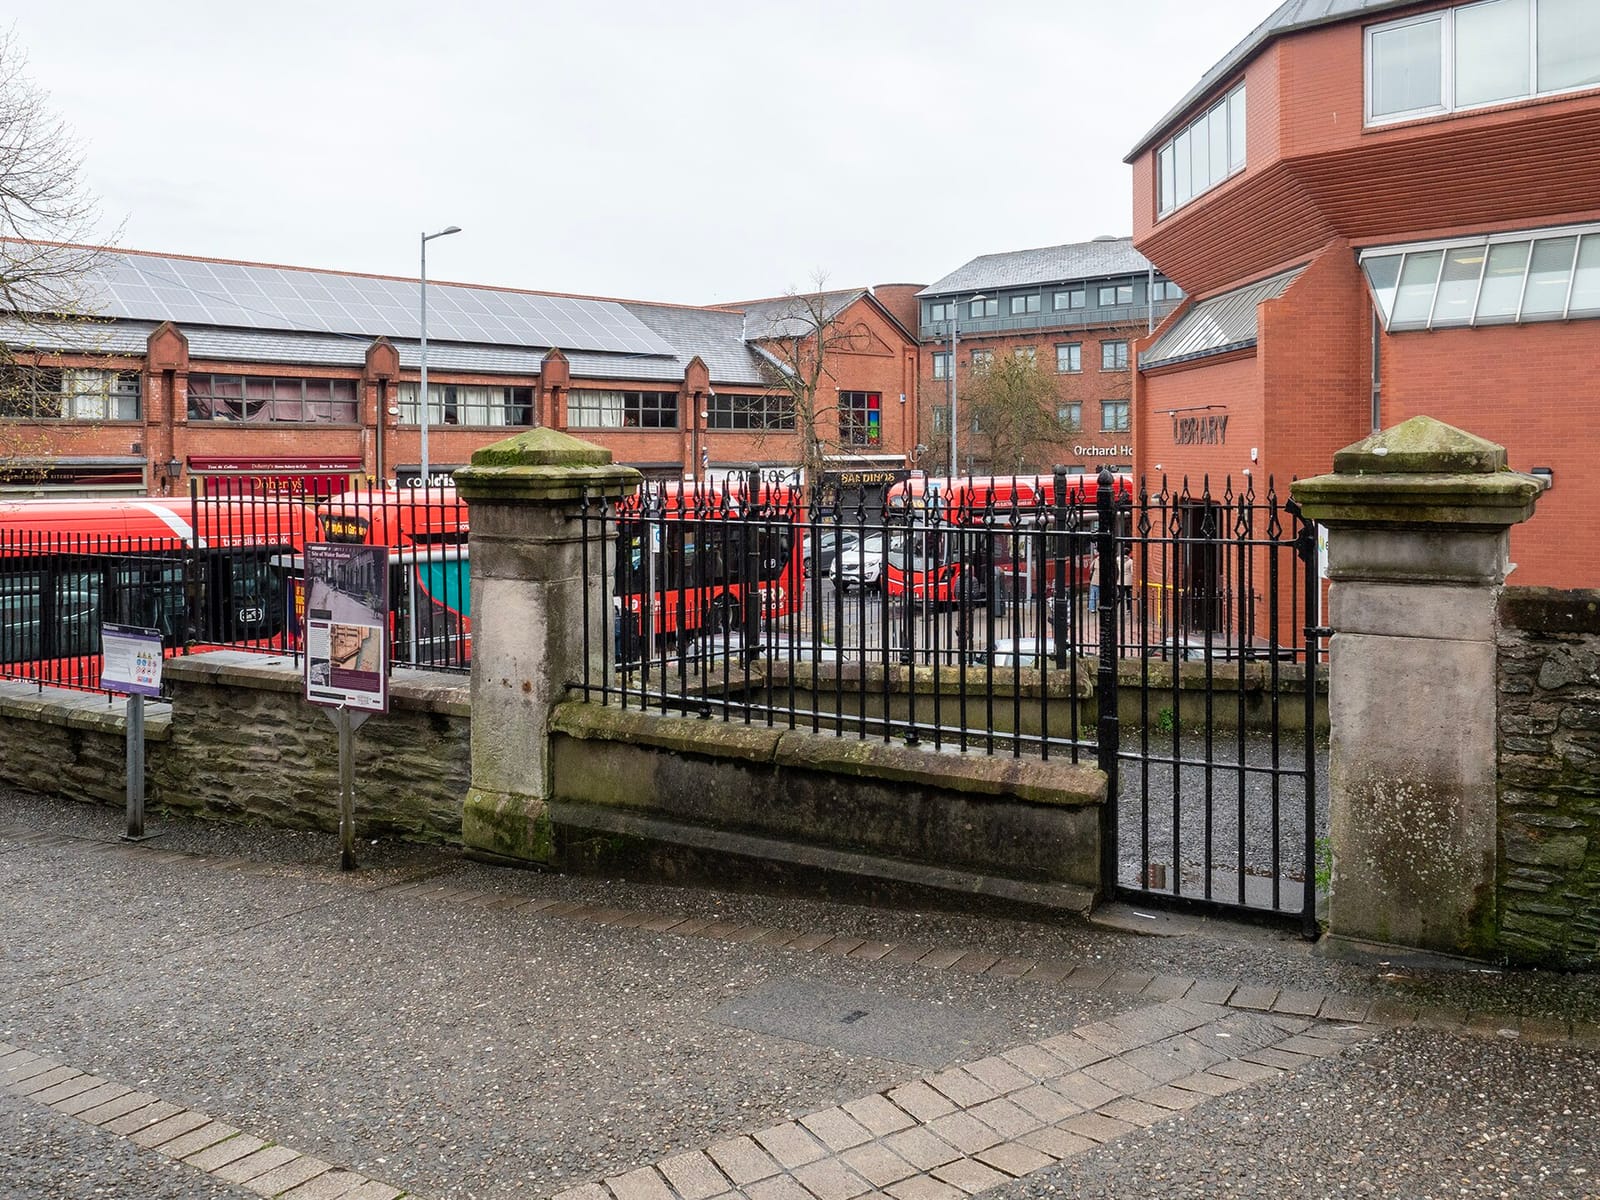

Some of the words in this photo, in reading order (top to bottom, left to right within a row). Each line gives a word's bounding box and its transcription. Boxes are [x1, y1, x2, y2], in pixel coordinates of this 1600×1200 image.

[1174, 415, 1228, 446] LIBRARY
[1074, 445, 1117, 456] Orchard
[251, 477, 303, 491] Dohery's
[406, 473, 456, 488] coldis
